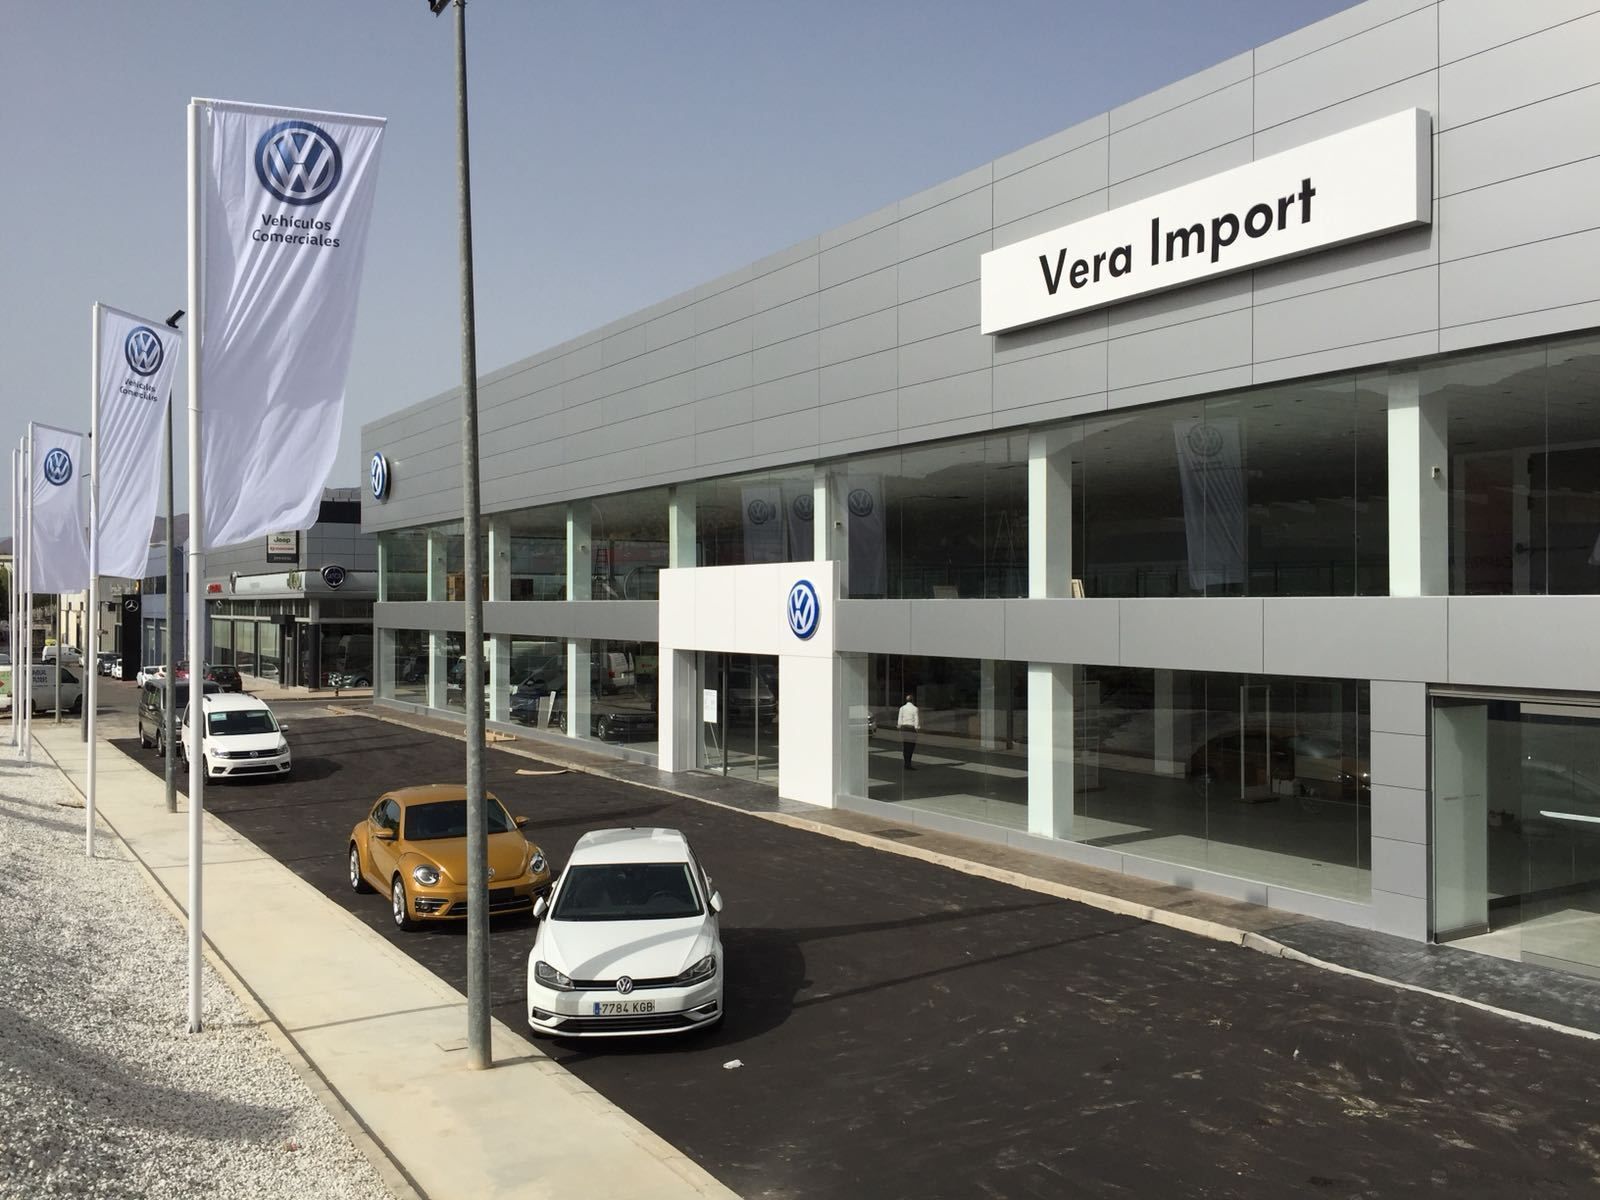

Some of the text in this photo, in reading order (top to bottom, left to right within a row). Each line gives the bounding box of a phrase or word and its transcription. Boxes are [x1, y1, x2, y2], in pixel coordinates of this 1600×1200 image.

[261, 213, 332, 231] Vehículos
[252, 229, 341, 248] Comerciales
[1039, 177, 1317, 296] Vera Import
[273, 536, 291, 544] Jeep
[602, 1001, 653, 1014] 7784 KGB
